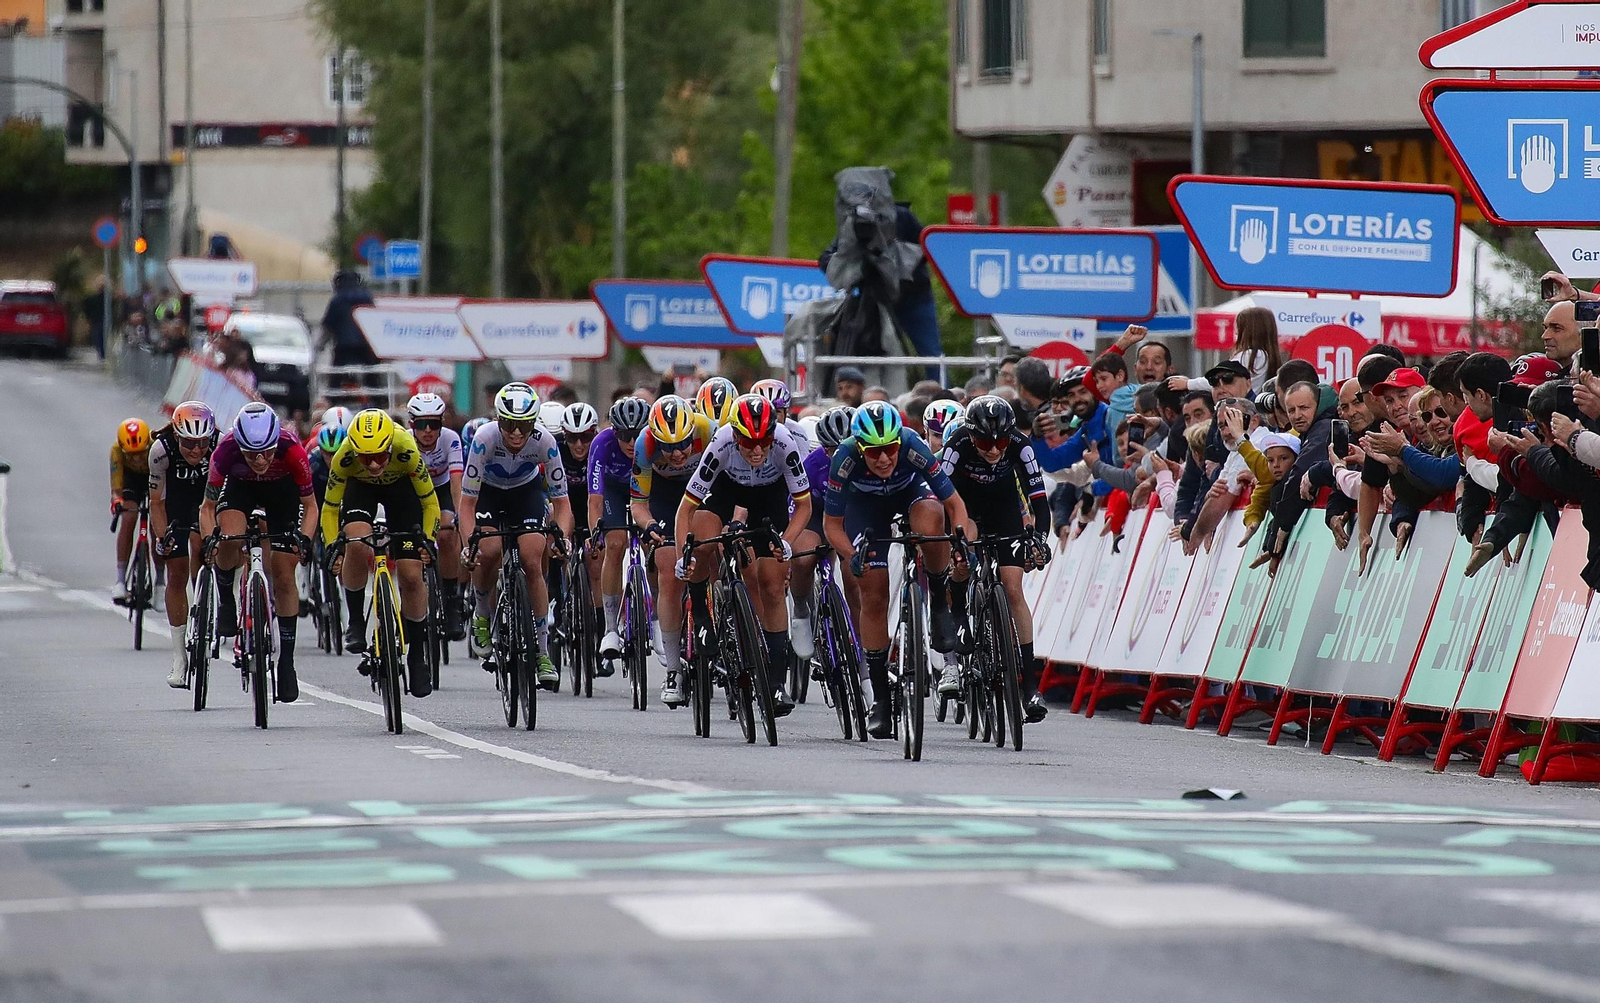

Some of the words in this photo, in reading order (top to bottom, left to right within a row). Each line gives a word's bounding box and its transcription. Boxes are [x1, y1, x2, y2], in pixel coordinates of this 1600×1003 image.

[1288, 212, 1433, 241] LOTERÍAS
[1298, 243, 1318, 251] CON
[1320, 244, 1329, 252] EL
[1017, 251, 1136, 275] LOTERÍAS
[1278, 311, 1336, 325] Carrefour
[1317, 346, 1353, 384] 50
[592, 460, 603, 491] Jayco
